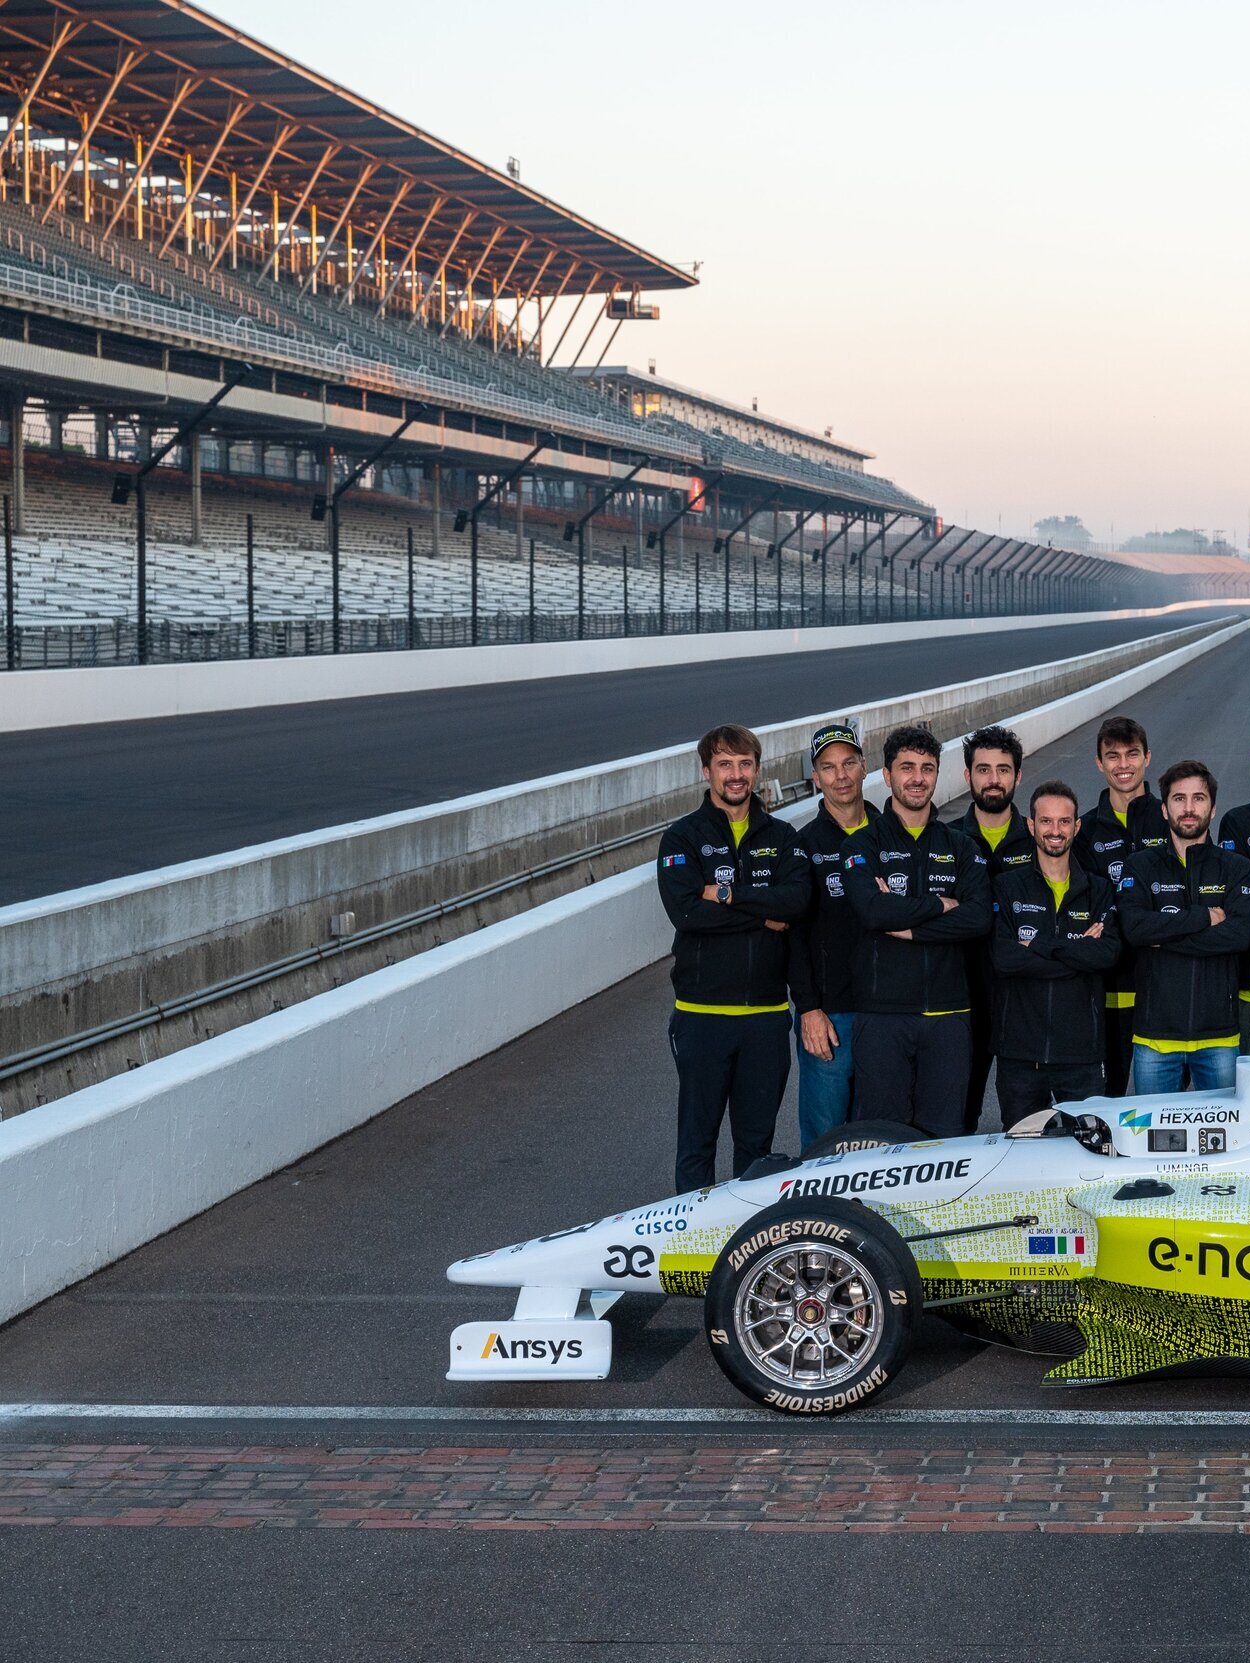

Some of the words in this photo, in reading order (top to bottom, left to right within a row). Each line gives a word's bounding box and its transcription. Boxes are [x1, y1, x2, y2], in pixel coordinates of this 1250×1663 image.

[1160, 1109, 1240, 1124] HEXAGON
[778, 1158, 972, 1202] BRIDGESTONE
[727, 1220, 851, 1273] BRIDGESTONE
[480, 1333, 583, 1365] Ansys
[764, 1363, 889, 1412] BRIDGESTONE
